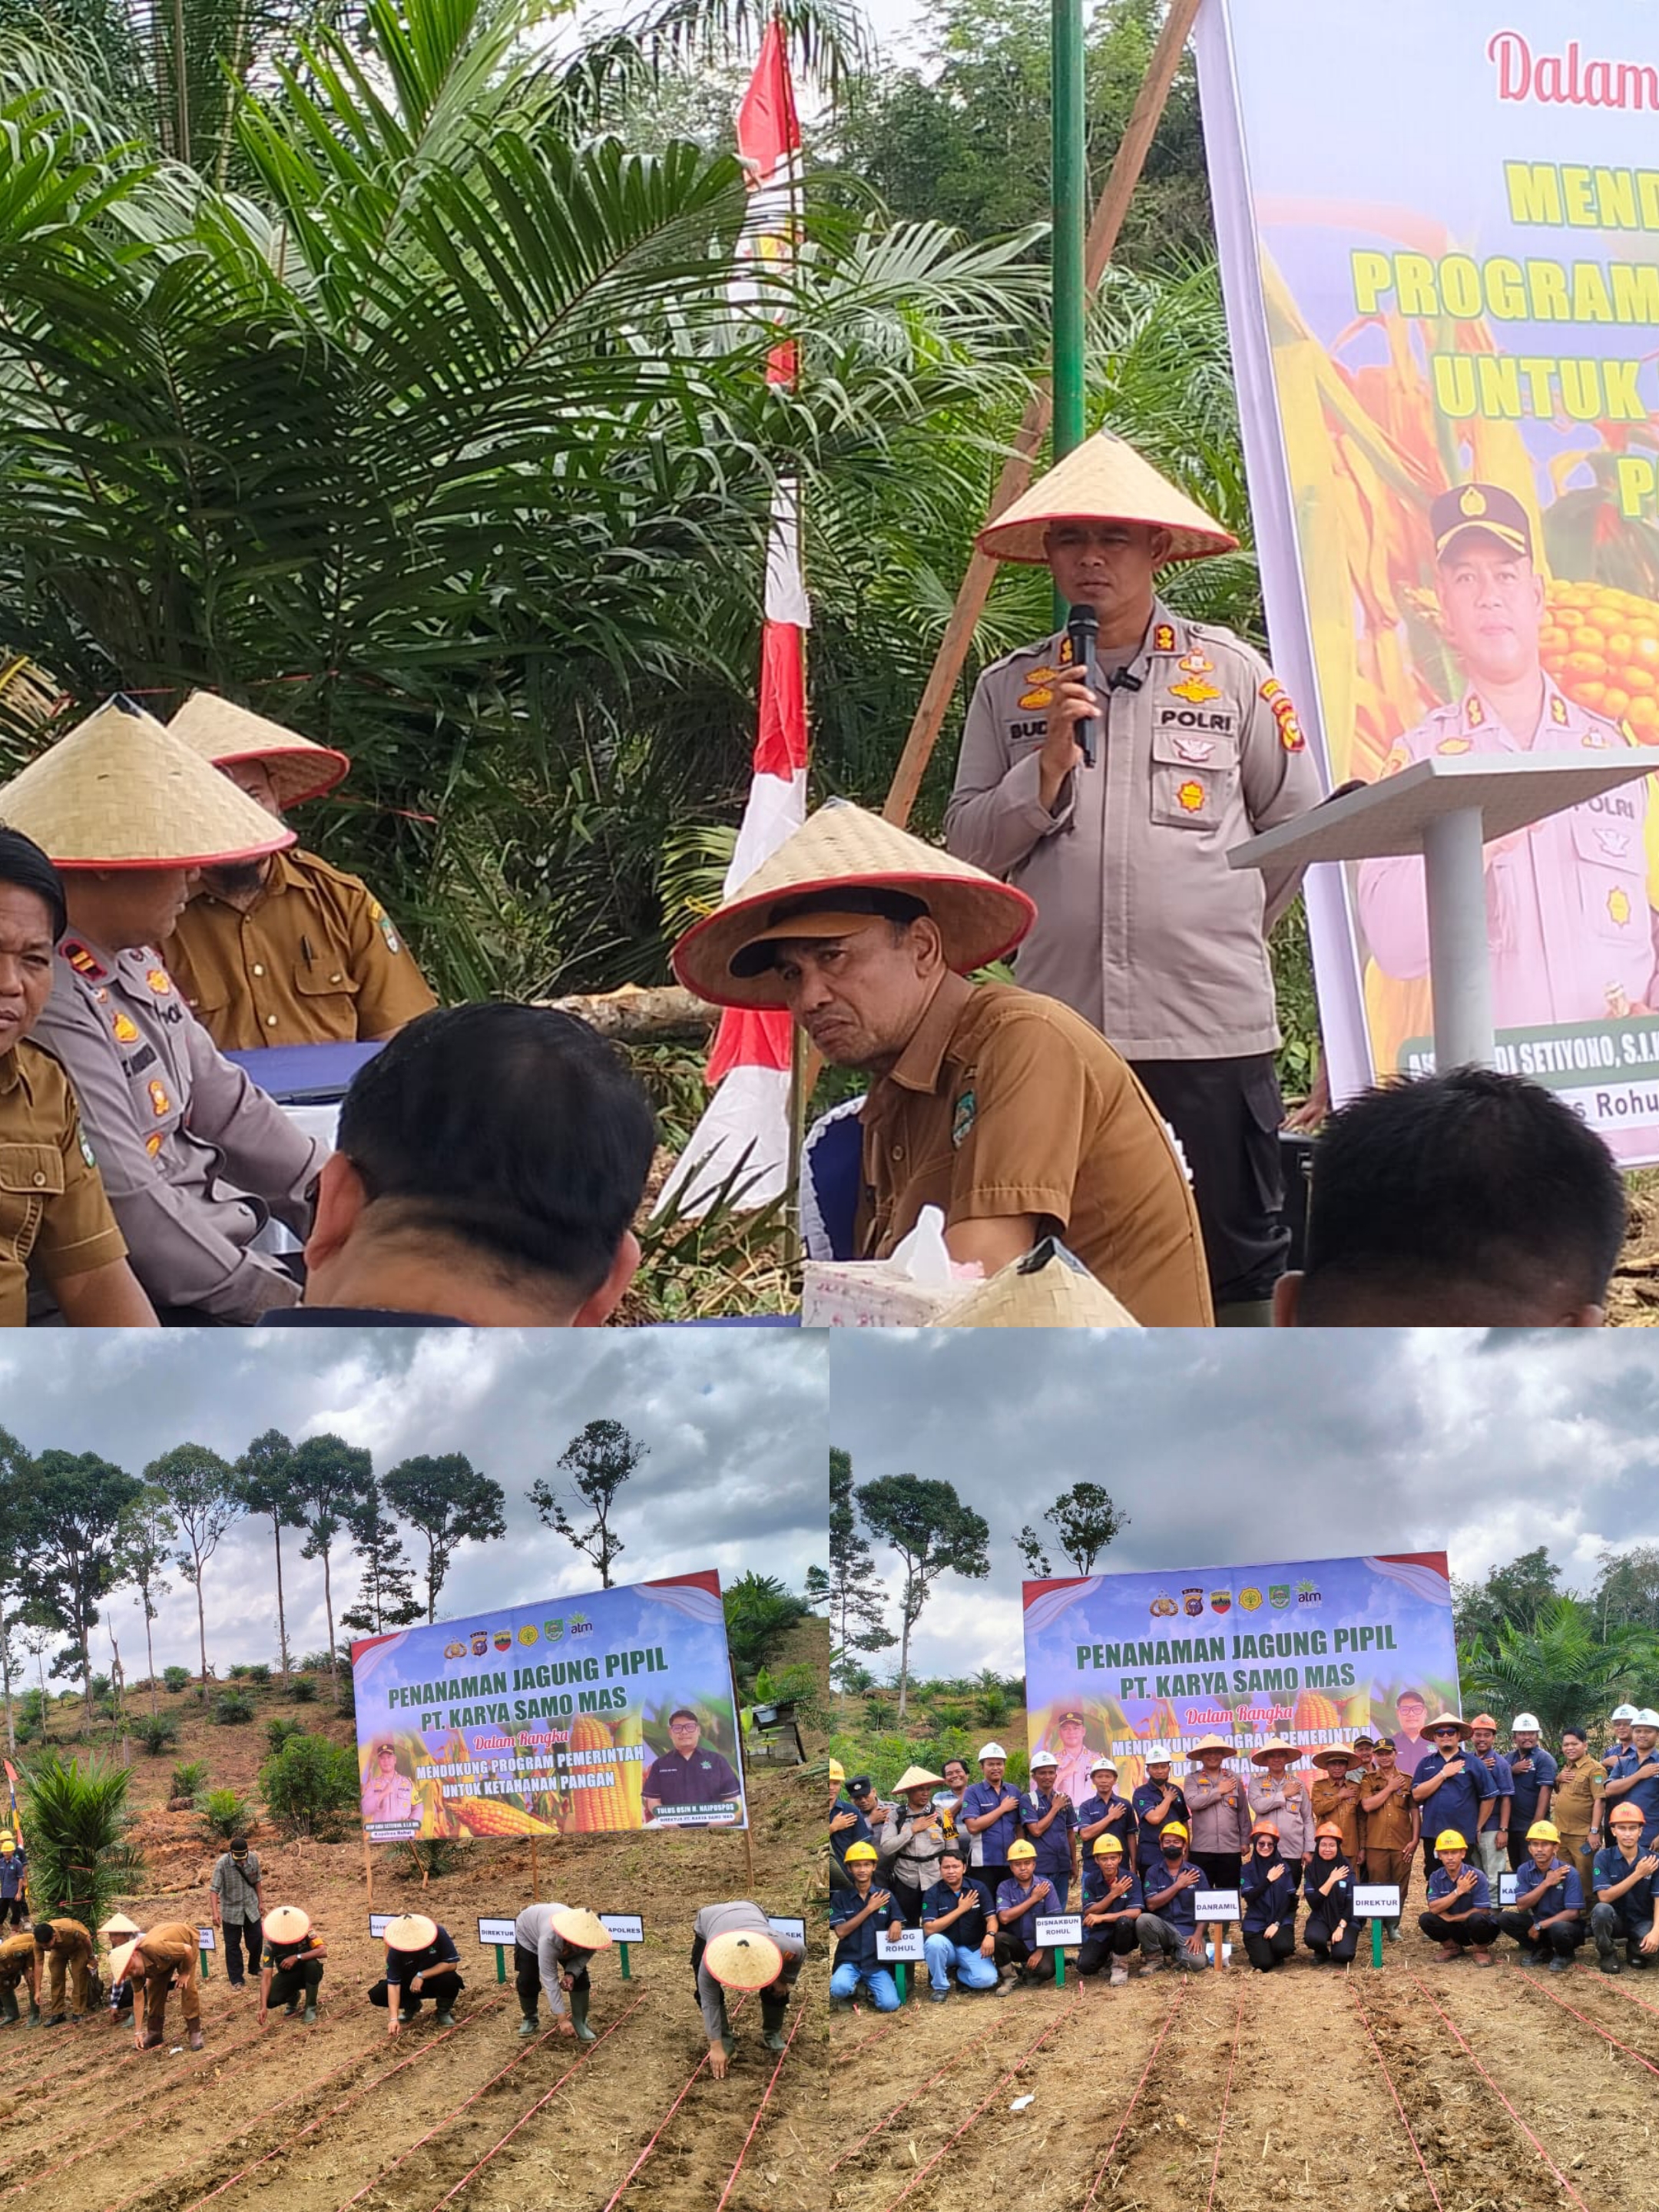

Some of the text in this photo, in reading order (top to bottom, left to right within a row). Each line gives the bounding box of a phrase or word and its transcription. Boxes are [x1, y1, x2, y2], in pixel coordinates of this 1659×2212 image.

[1487, 31, 1659, 111] Dalam
[1350, 249, 1659, 324] PROGRAM
[1433, 354, 1648, 421] UNTUK
[1010, 720, 1048, 740] BUD
[1161, 710, 1231, 730] POLRI
[1576, 797, 1634, 820] OLRI
[1519, 1035, 1620, 1074] SETIYONO,
[1076, 1624, 1397, 1670] PENANAMAN JAGUNG PIPIL
[388, 1647, 669, 1710] PENANAMAN JAGUNG PIPIL
[1120, 1663, 1356, 1700] PT. KARYA SAMO MAS
[421, 1686, 628, 1732] PT. KARYA SAMO MAS
[1185, 1704, 1294, 1725] Dalam Rangka
[474, 1728, 569, 1751] Dalam Rangka
[416, 1746, 644, 1780] MENDUKUNG PROGRAM PEMERINTAH
[442, 1771, 615, 1798] UNTUK KETAHANAN PANGAN
